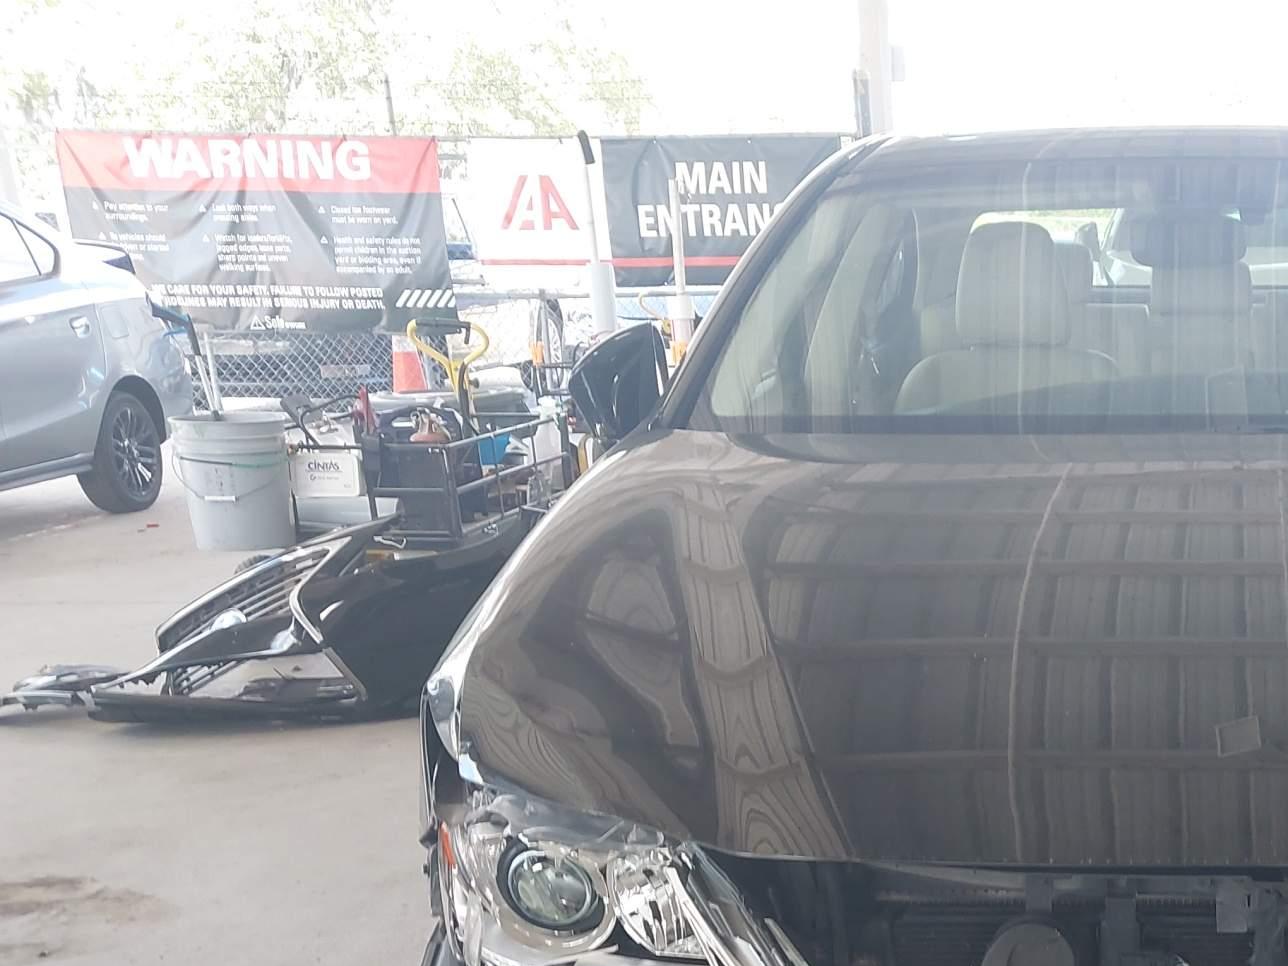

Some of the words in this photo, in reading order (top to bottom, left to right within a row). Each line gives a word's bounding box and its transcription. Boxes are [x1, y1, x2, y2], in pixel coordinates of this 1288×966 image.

[123, 137, 371, 181] WARNING
[674, 161, 767, 195] MAIN
[190, 284, 210, 296] FOR
[209, 285, 236, 296] YOUR
[303, 287, 315, 297] TO
[315, 287, 349, 298] FOLLOW
[349, 288, 384, 299] POSTED
[206, 297, 229, 308] MAY
[229, 297, 262, 308] RESULT
[309, 299, 341, 310] INJURY
[341, 300, 355, 310] OR
